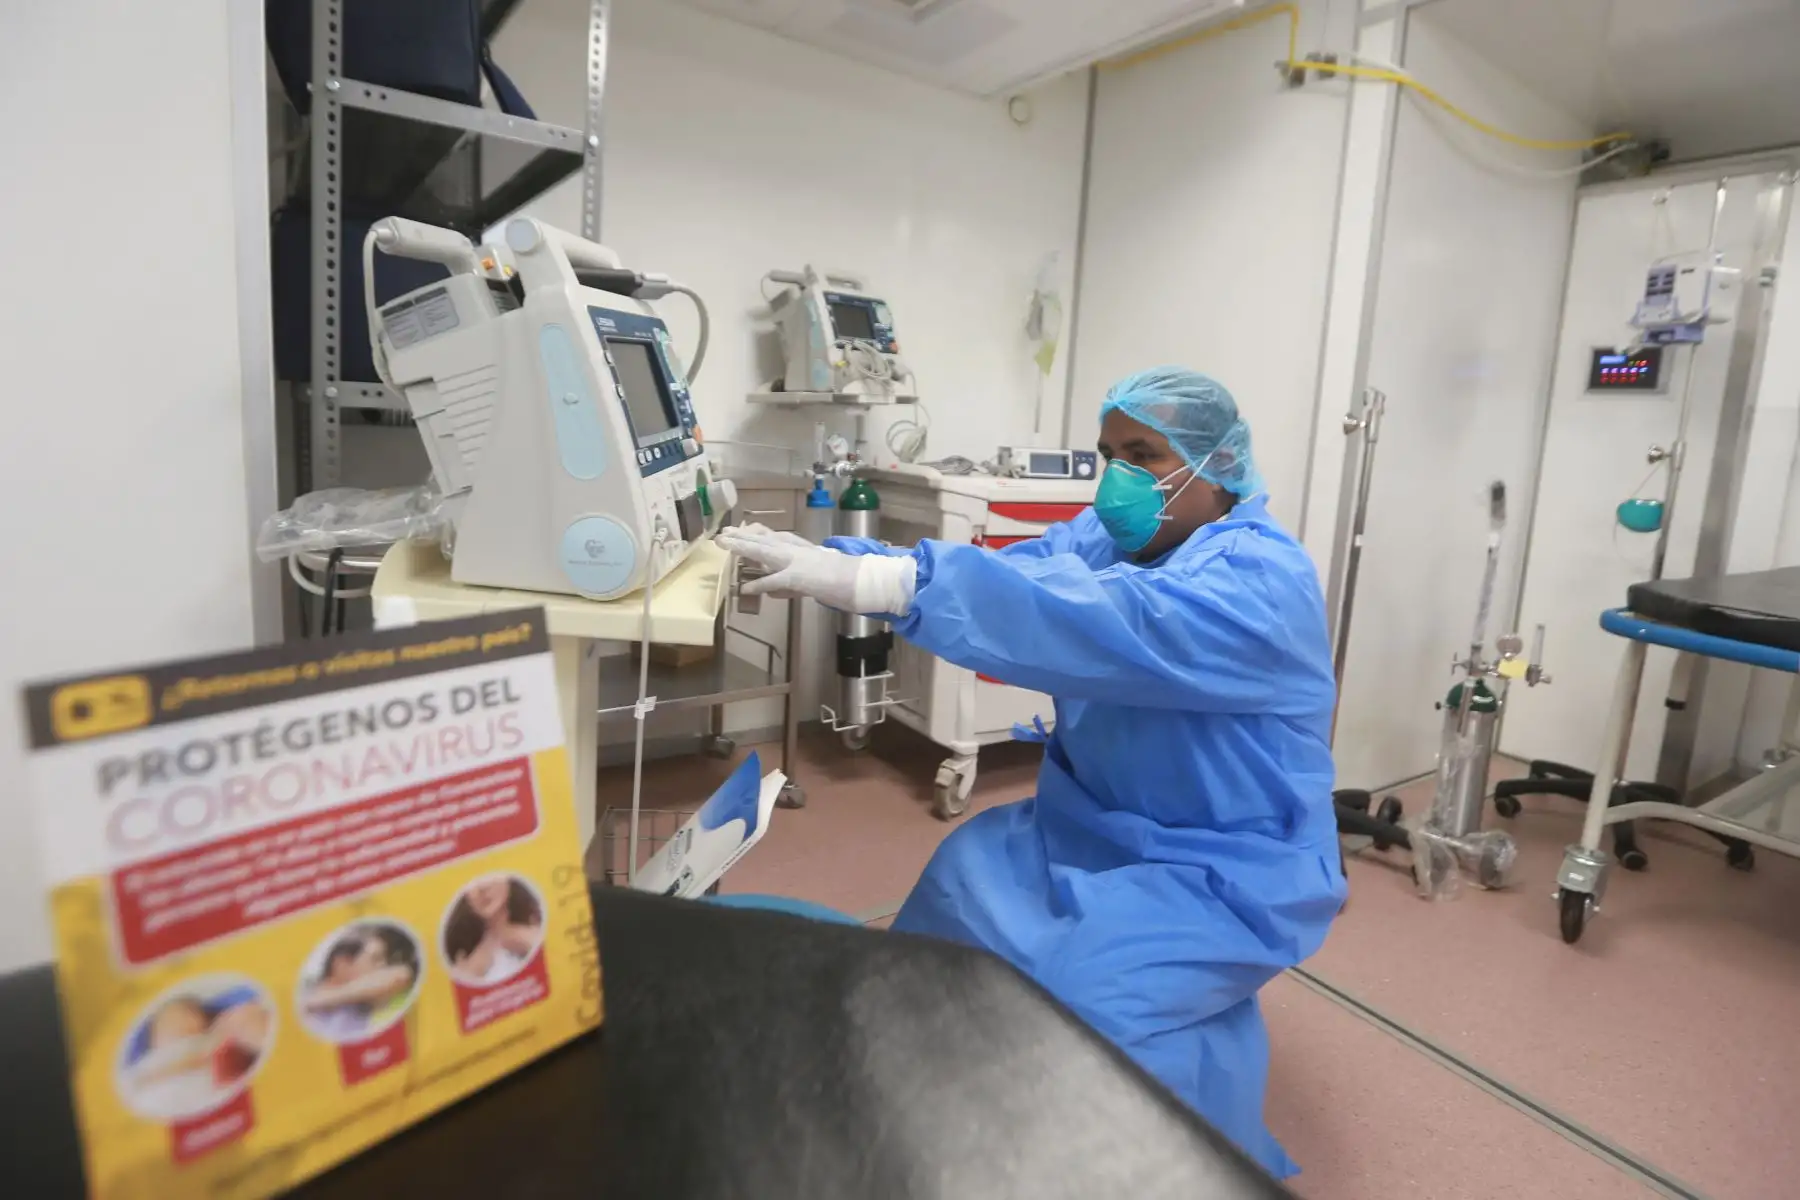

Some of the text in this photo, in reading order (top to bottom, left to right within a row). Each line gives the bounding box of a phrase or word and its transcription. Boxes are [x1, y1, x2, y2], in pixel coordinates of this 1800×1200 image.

[97, 677, 520, 797] PROTÉGENOS DEL
[106, 712, 524, 853] CORONAVIRUS
